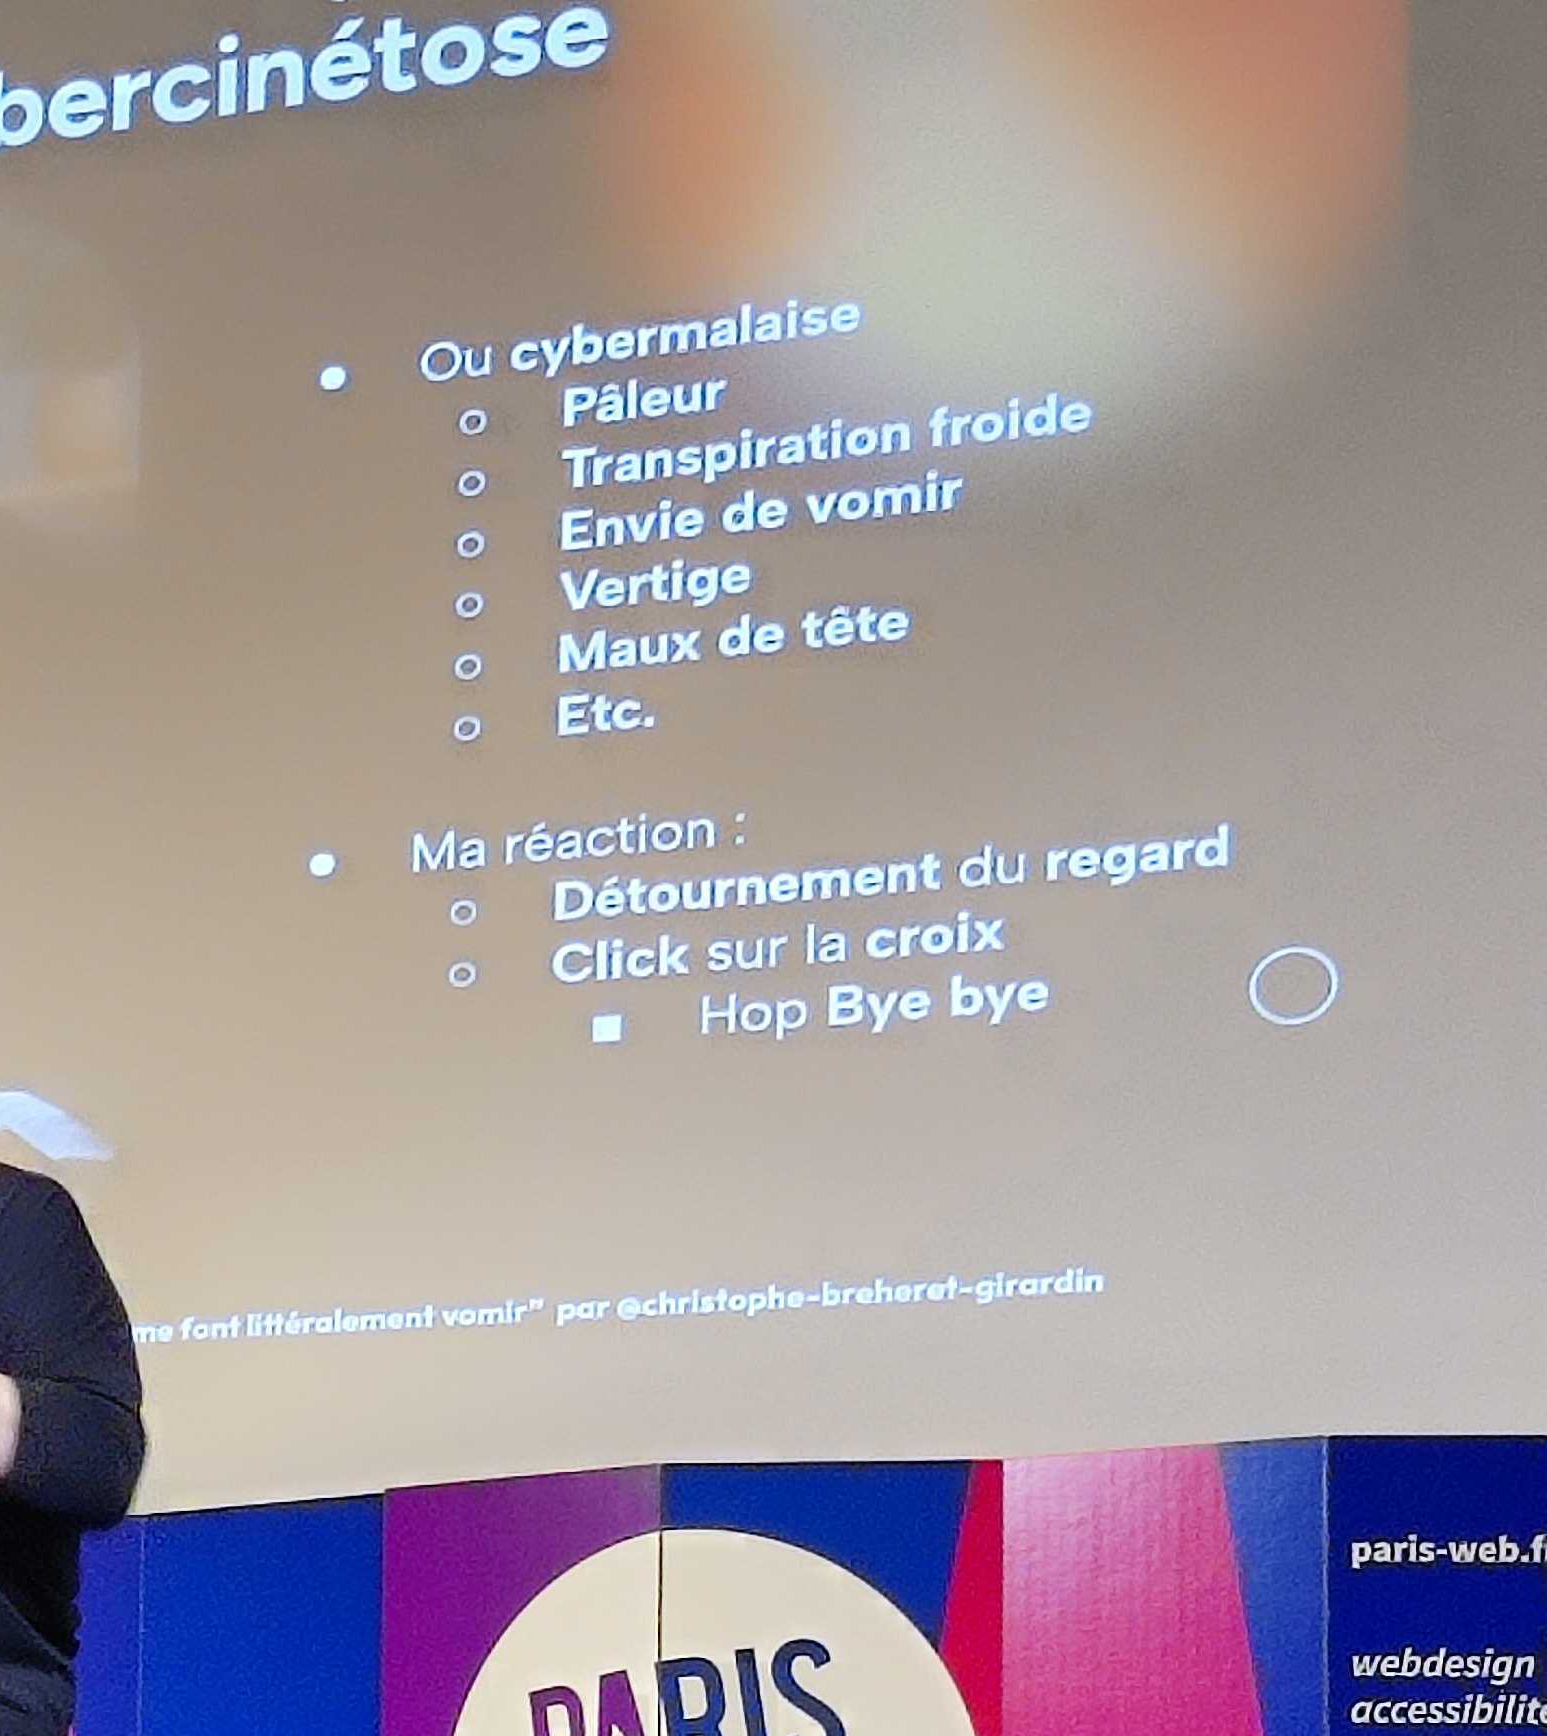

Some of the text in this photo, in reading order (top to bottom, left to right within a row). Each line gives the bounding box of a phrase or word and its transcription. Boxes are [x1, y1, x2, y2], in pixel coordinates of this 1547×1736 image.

[421, 299, 862, 383] Ou cybermalaise
[561, 376, 726, 427] Pâleur
[561, 392, 1092, 488] Transpiration froide
[560, 470, 963, 552] Envie de vomir
[560, 561, 751, 612] Vertige
[558, 605, 909, 673] Maux de tête
[557, 692, 655, 737] Etc.
[412, 833, 486, 873] Ma
[504, 813, 715, 865] réaction
[552, 824, 1230, 923] Détournement du regard
[552, 912, 1003, 983] Click sur la croix
[699, 976, 1049, 1039] Hop Bye bye
[179, 1315, 241, 1341] font
[246, 1304, 432, 1337] littéralement
[555, 1298, 610, 1326] par
[1351, 1535, 1547, 1568] paris-web.f
[1352, 1648, 1535, 1685] webdesign
